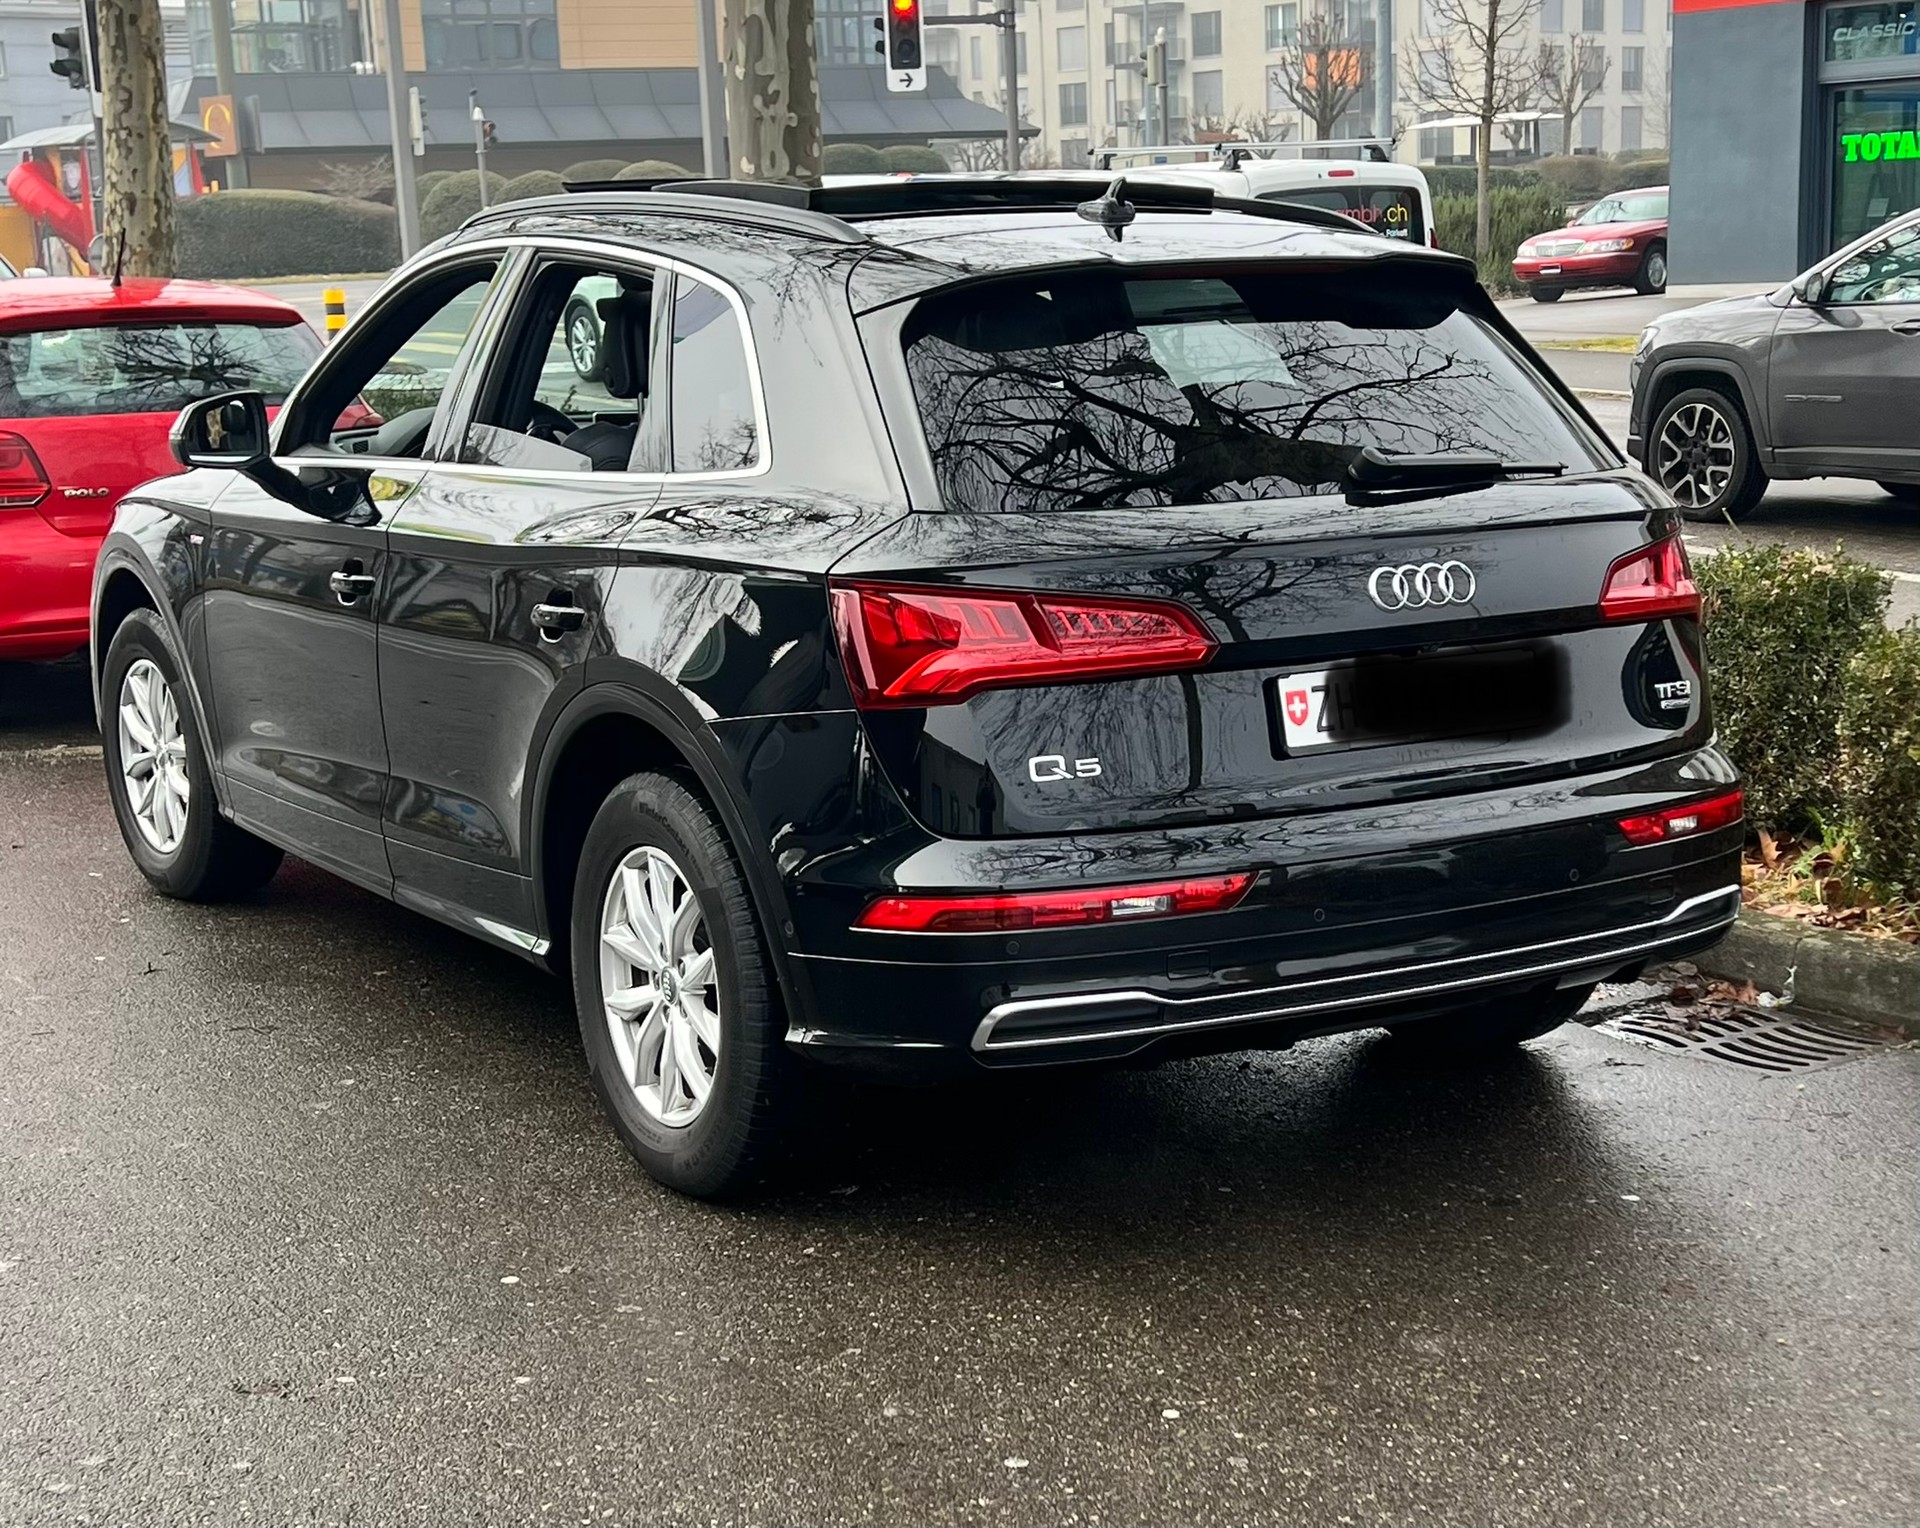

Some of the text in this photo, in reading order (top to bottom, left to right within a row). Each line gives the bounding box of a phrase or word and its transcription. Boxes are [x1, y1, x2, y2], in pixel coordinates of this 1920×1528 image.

[1833, 22, 1916, 42] CLASSIC
[1842, 131, 1920, 162] TOTA
[64, 487, 109, 498] POLO
[1028, 754, 1102, 782] Q5
